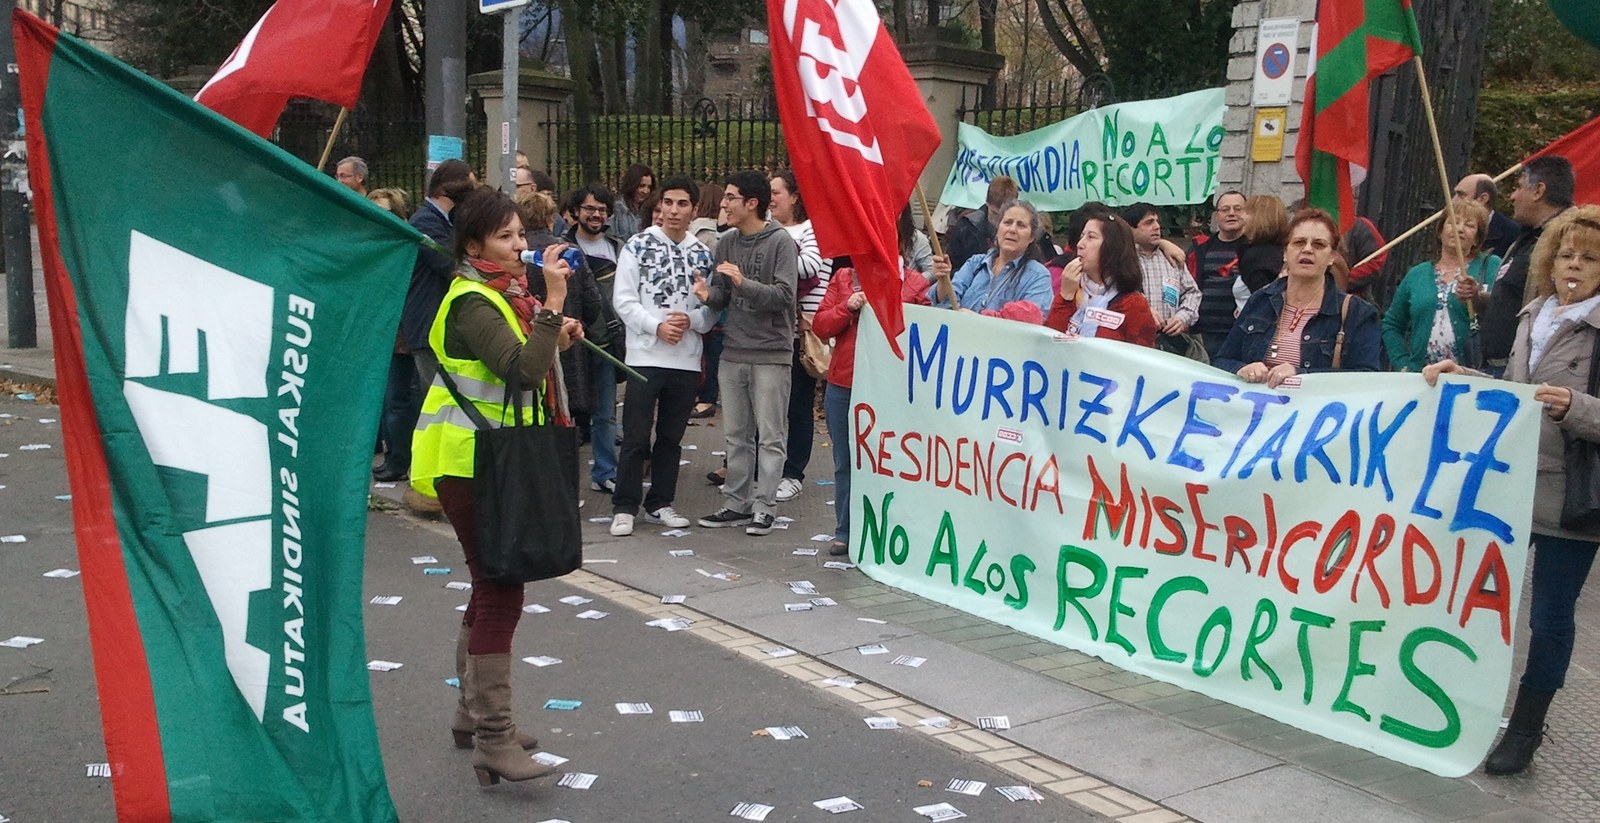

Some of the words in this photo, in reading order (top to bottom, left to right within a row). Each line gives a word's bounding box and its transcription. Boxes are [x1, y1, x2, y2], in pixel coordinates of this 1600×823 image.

[1146, 122, 1169, 157] A
[853, 403, 1063, 515] RESIDENCIA
[1083, 454, 1511, 645] MISERICORDIA
[908, 322, 1418, 502] MURRIZKETARIK
[1412, 382, 1520, 545] EZ
[1056, 544, 1477, 749] RECORTES
